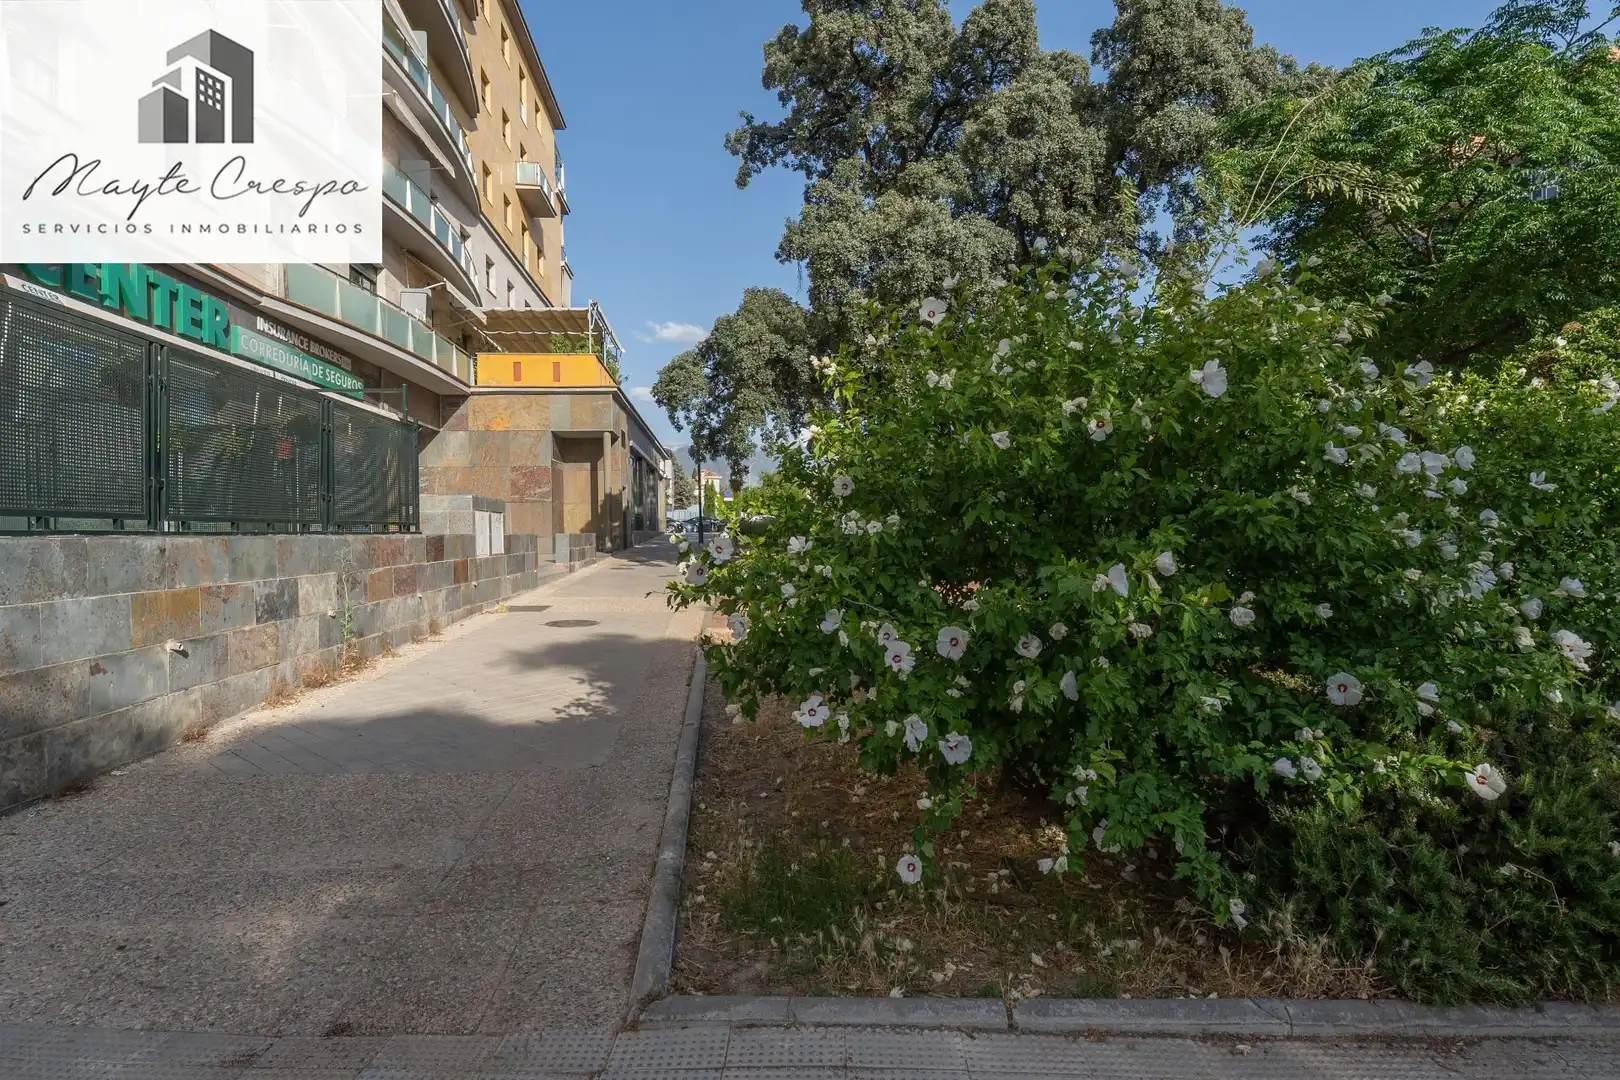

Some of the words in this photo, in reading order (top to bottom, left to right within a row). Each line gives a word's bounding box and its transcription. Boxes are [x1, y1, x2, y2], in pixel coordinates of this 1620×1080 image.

[241, 334, 309, 372] CORREDURÍA
[312, 363, 323, 378] DE
[325, 368, 364, 393] SEGUROS
[256, 316, 309, 350] INSURANCE
[309, 340, 342, 367] BROKERS
